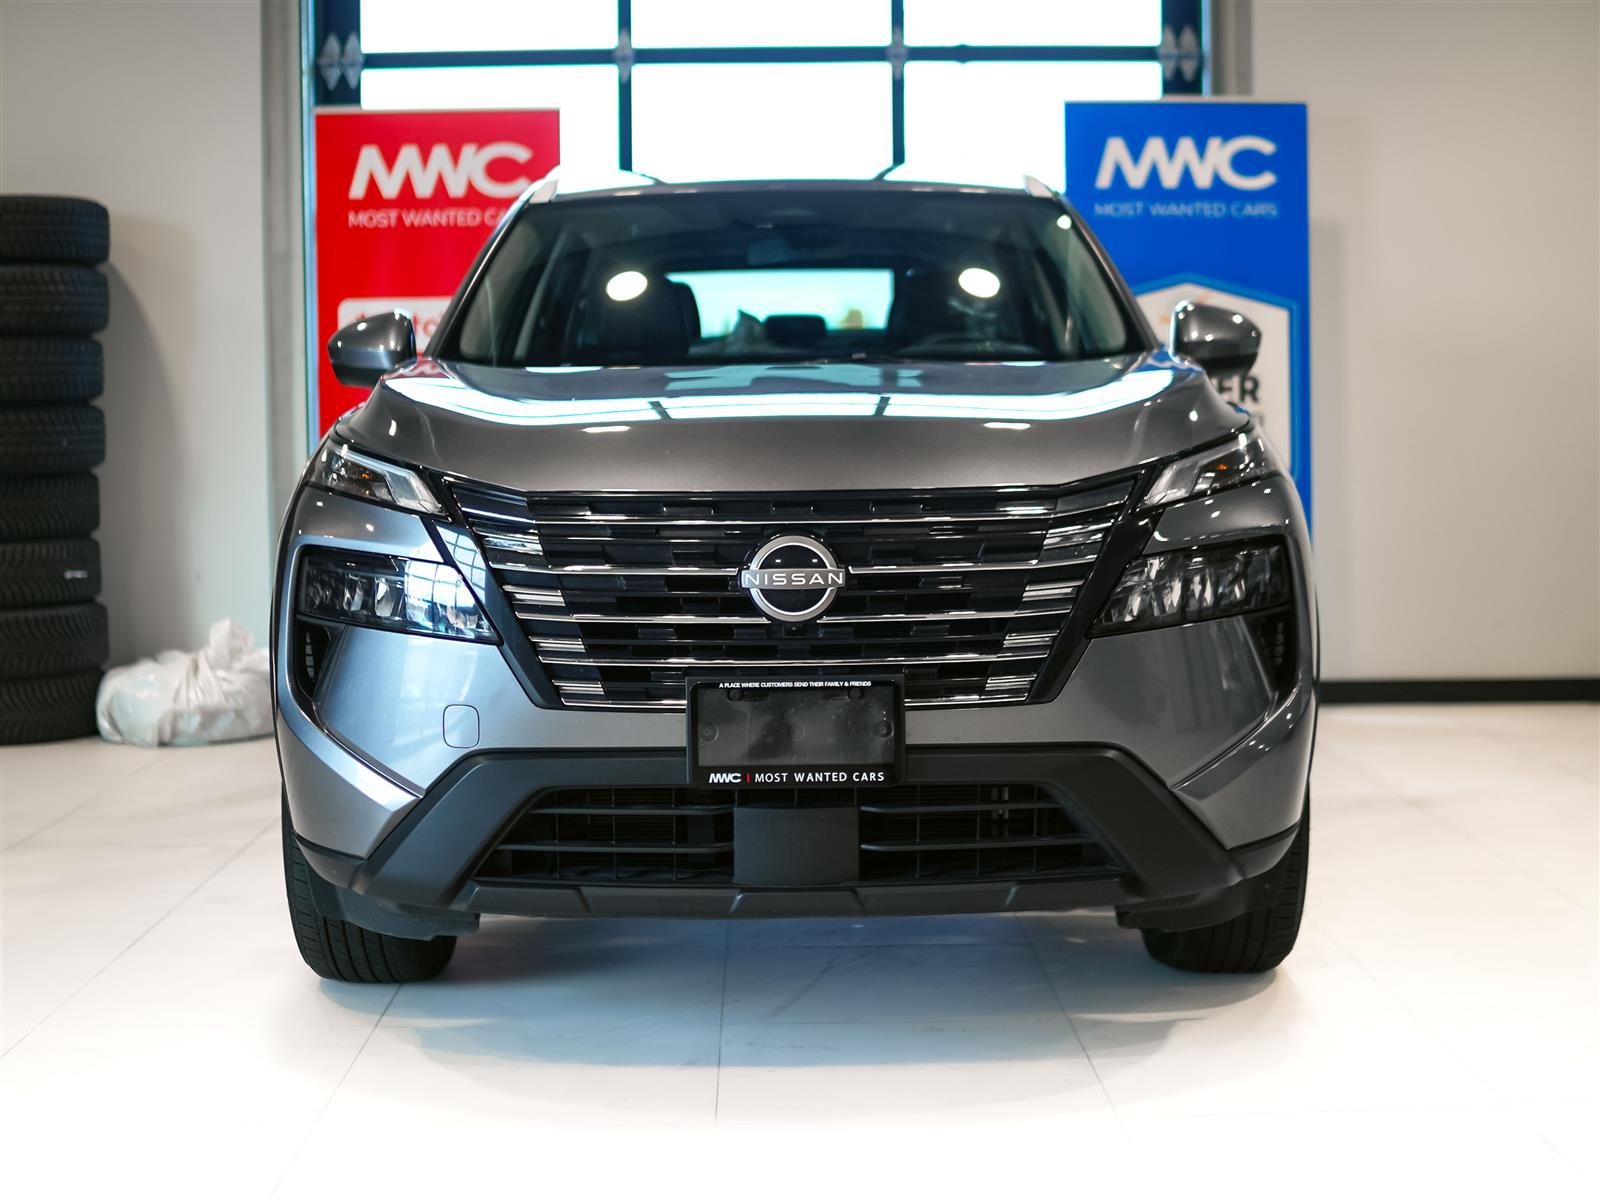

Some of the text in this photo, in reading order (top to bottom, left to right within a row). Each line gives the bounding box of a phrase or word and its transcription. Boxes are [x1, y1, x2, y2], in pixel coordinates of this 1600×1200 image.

[348, 140, 533, 200] MWC
[1094, 134, 1277, 191] MWC
[348, 208, 398, 228] MOST
[402, 207, 481, 227] WANTED
[1094, 202, 1279, 218] MOST WANTED CARS
[745, 572, 843, 586] NISSAN
[755, 773, 788, 782] MOST
[794, 772, 847, 782] WANTED
[852, 772, 885, 781] CARS
